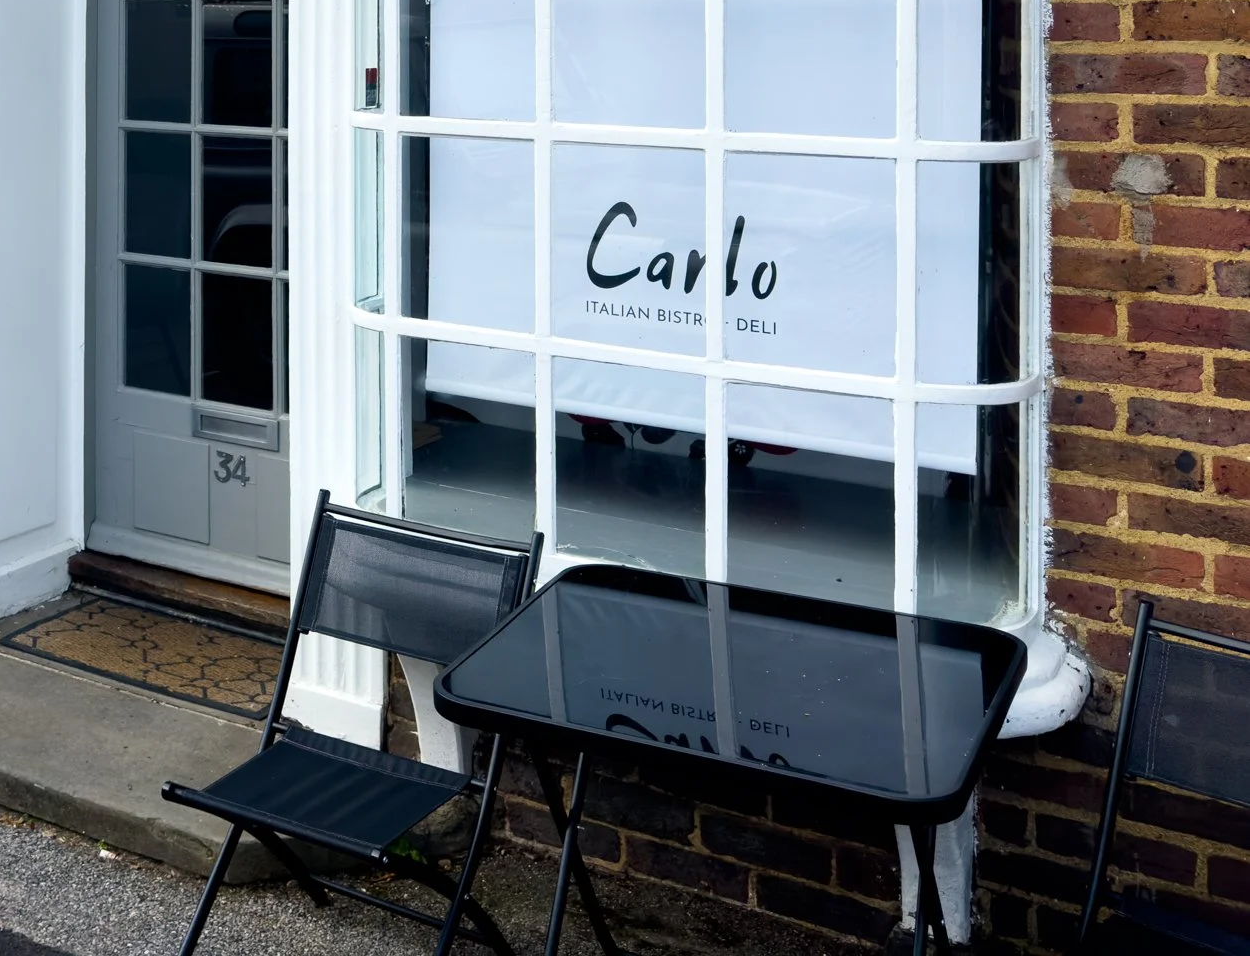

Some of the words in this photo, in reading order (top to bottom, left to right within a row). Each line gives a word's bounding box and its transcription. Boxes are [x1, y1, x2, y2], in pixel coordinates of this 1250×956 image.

[587, 201, 777, 300] Carlo
[586, 300, 650, 320] ITALIAN
[657, 309, 707, 327] BISTR
[737, 318, 777, 335] DELI
[214, 450, 250, 487] 34
